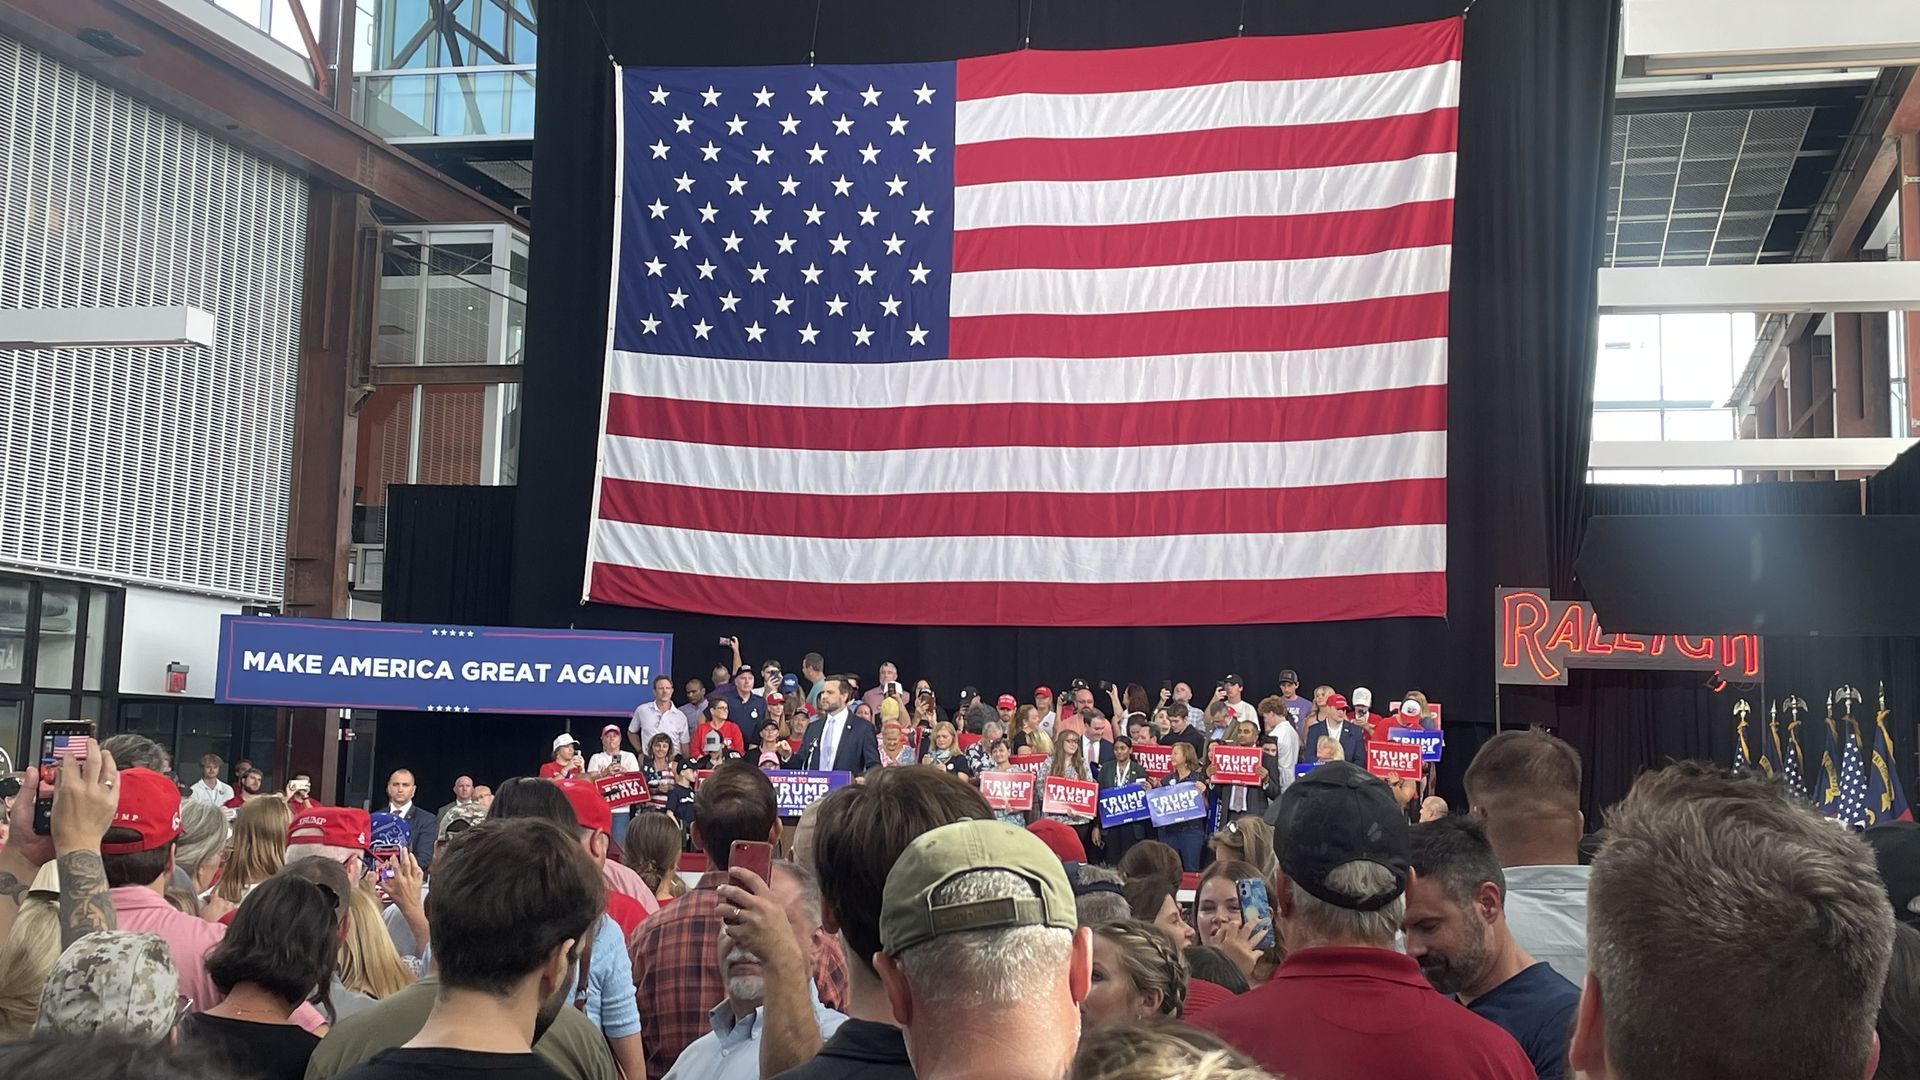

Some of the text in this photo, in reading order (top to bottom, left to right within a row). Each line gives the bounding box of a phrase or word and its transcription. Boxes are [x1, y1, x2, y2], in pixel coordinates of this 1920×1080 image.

[243, 650, 649, 685] MAKE AMERICA GREAT AGAIN!
[1215, 754, 1259, 765] TRUMP
[1371, 749, 1419, 761] TRUMP
[1219, 763, 1254, 773] VANCE
[1376, 758, 1414, 768] VANCE
[984, 780, 1031, 790] TRUMP
[1048, 784, 1095, 797] TRUMP
[989, 788, 1025, 798] VANCE
[1052, 793, 1089, 804] VANCE
[1150, 789, 1199, 807] TRUMP
[1100, 790, 1146, 808] TRUMP
[1107, 800, 1143, 814] VANCE
[1158, 799, 1195, 814] VANCE
[113, 812, 139, 821] UMP
